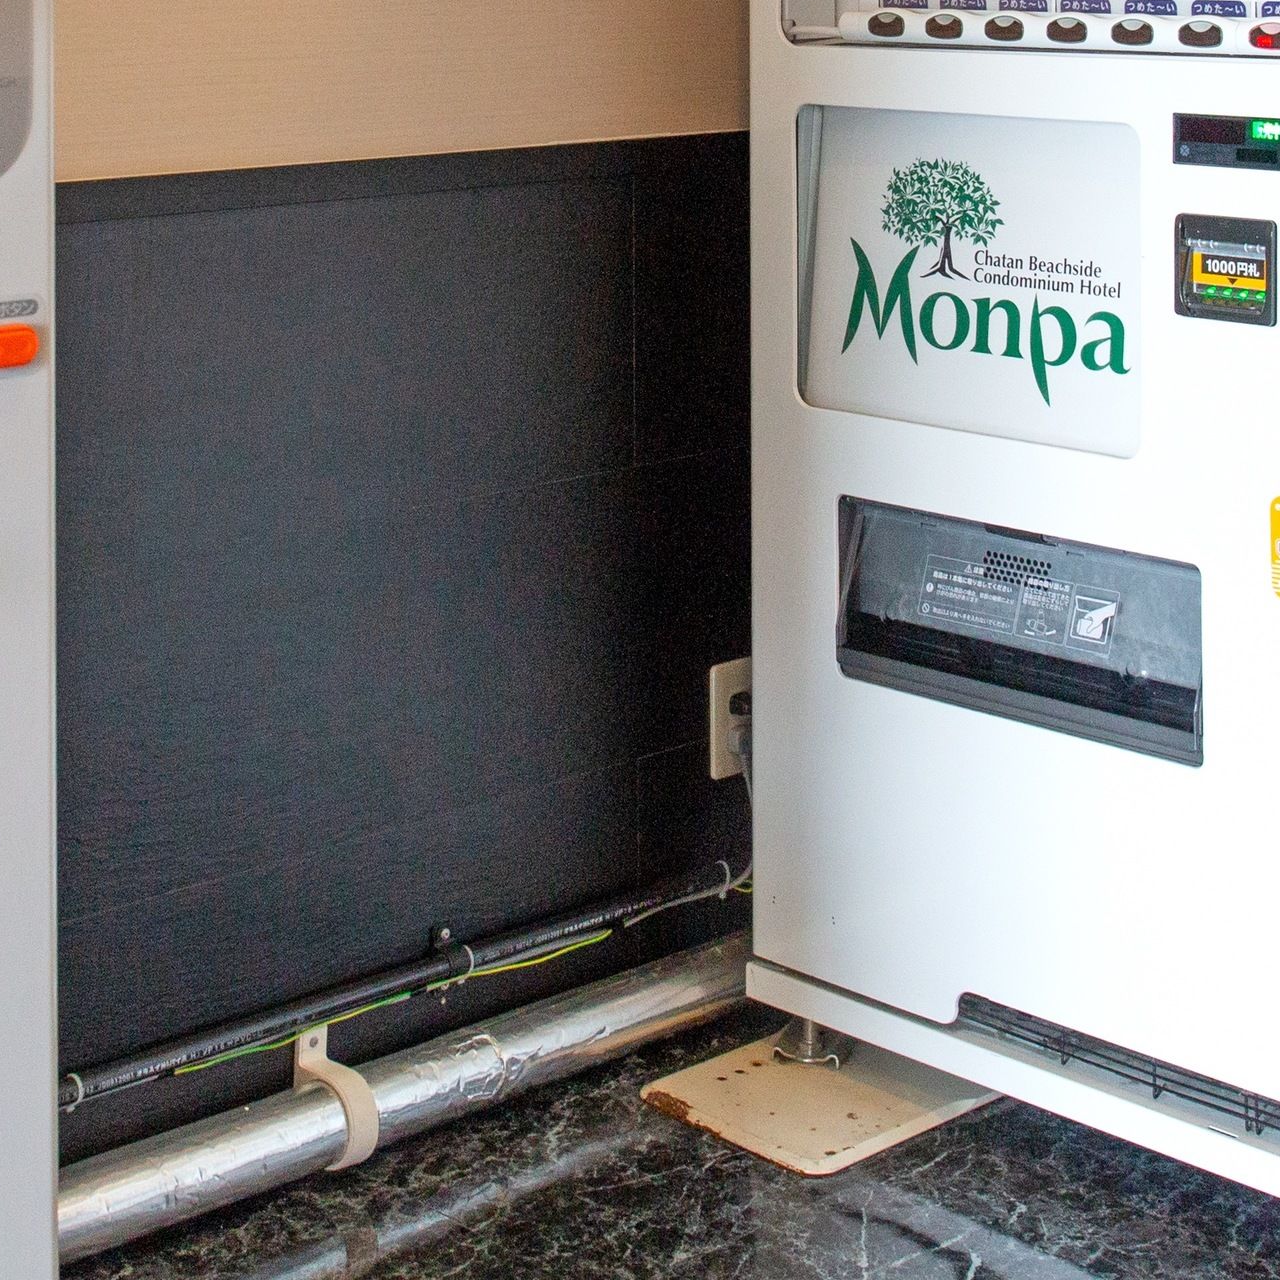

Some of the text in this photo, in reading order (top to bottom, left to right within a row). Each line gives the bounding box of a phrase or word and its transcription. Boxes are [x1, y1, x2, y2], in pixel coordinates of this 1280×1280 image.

[974, 249, 1102, 279] Chatan Beachside
[1206, 258, 1261, 277] 1000円札
[973, 267, 1122, 299] Condominium Hotel
[841, 236, 1132, 408] Monpa
